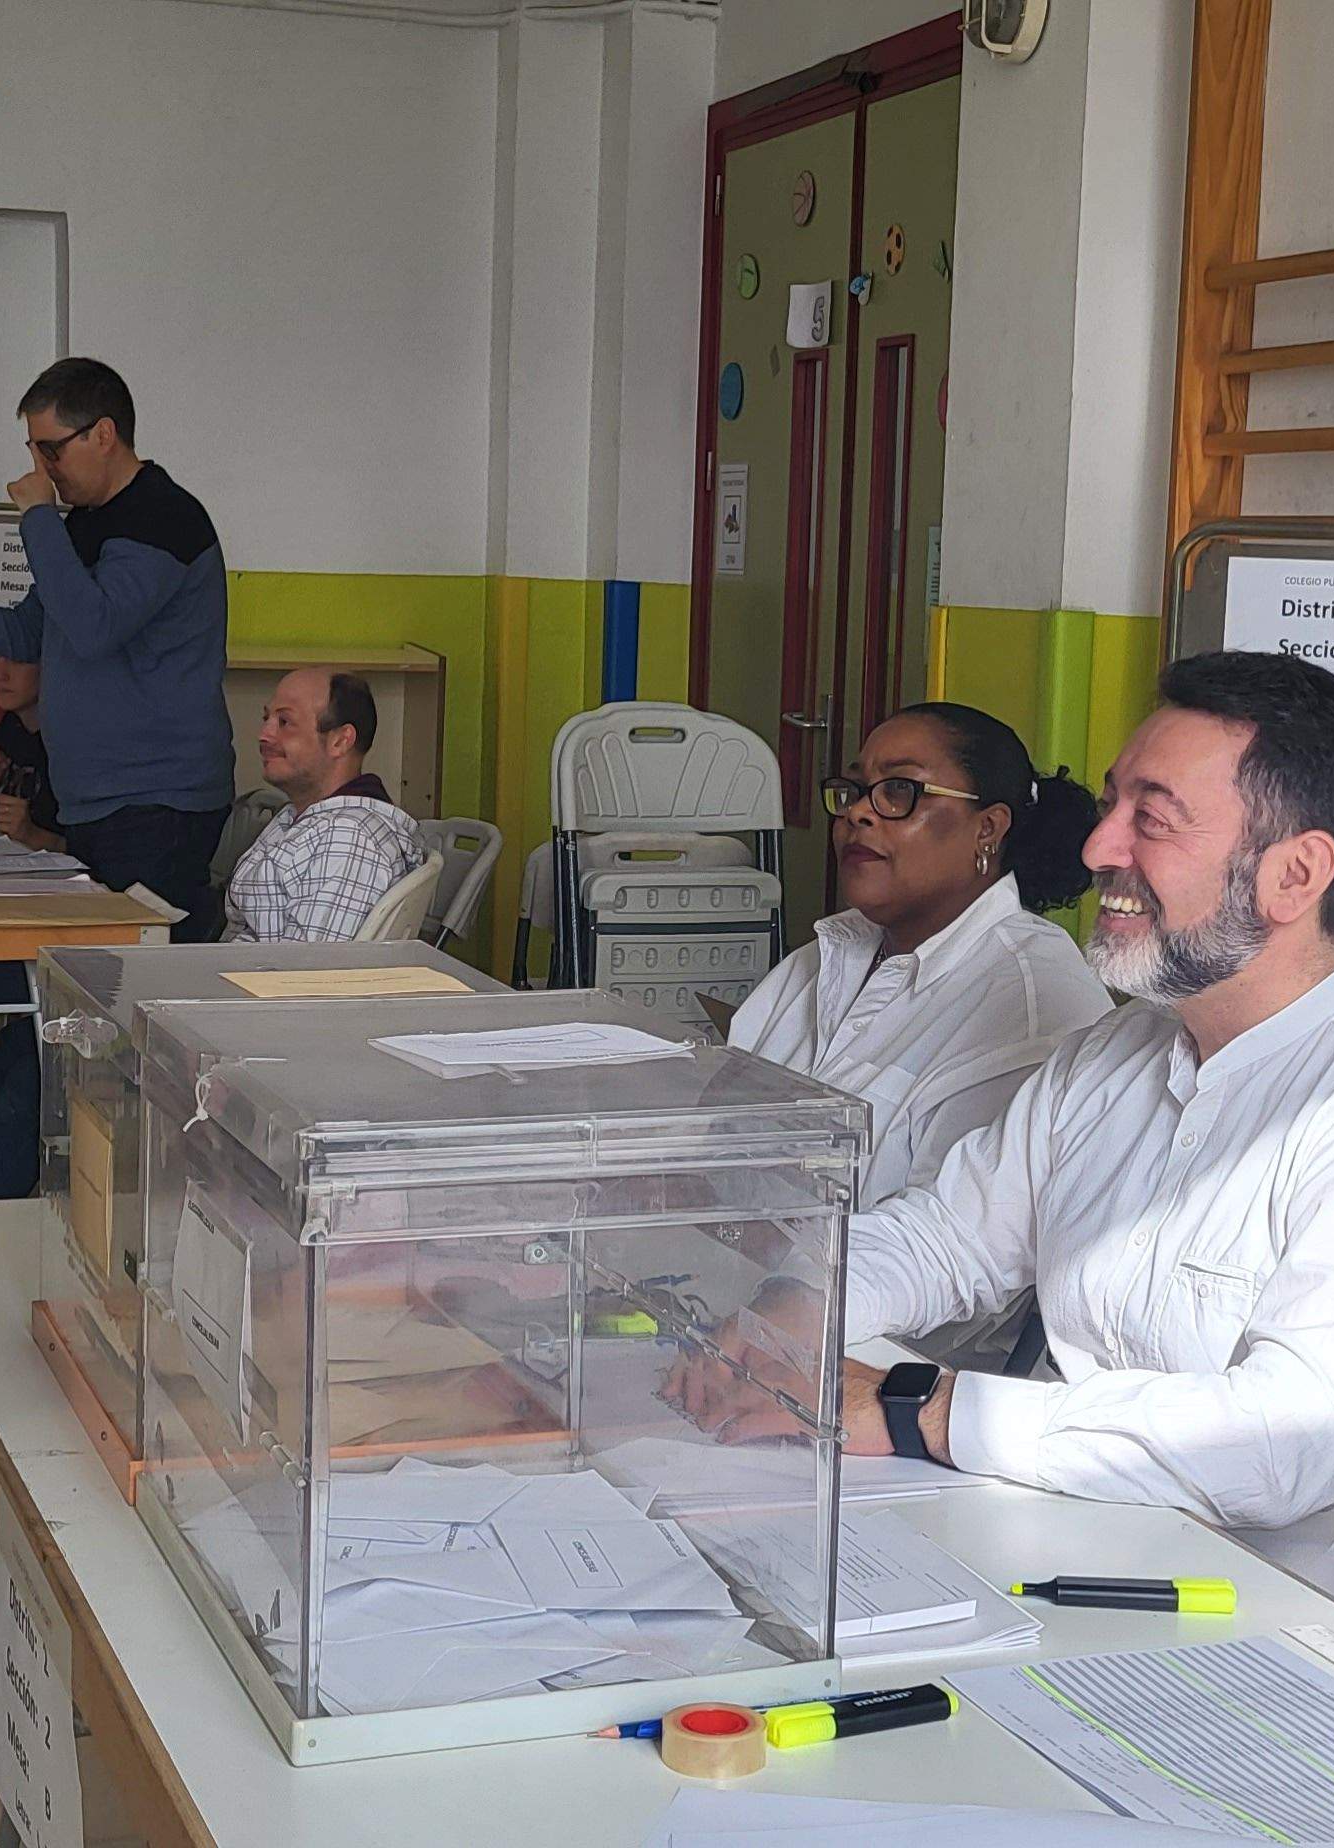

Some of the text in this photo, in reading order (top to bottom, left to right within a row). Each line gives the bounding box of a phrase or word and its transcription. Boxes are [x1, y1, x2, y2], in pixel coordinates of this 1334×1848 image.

[811, 295, 825, 342] 5
[3, 542, 24, 553] Distr
[1284, 576, 1322, 586] COLEGIO
[9, 1577, 37, 1659] Distrito:
[6, 1646, 38, 1729] Sección:
[44, 1715, 51, 1750] 2
[7, 1711, 52, 1821] Mesa: B
